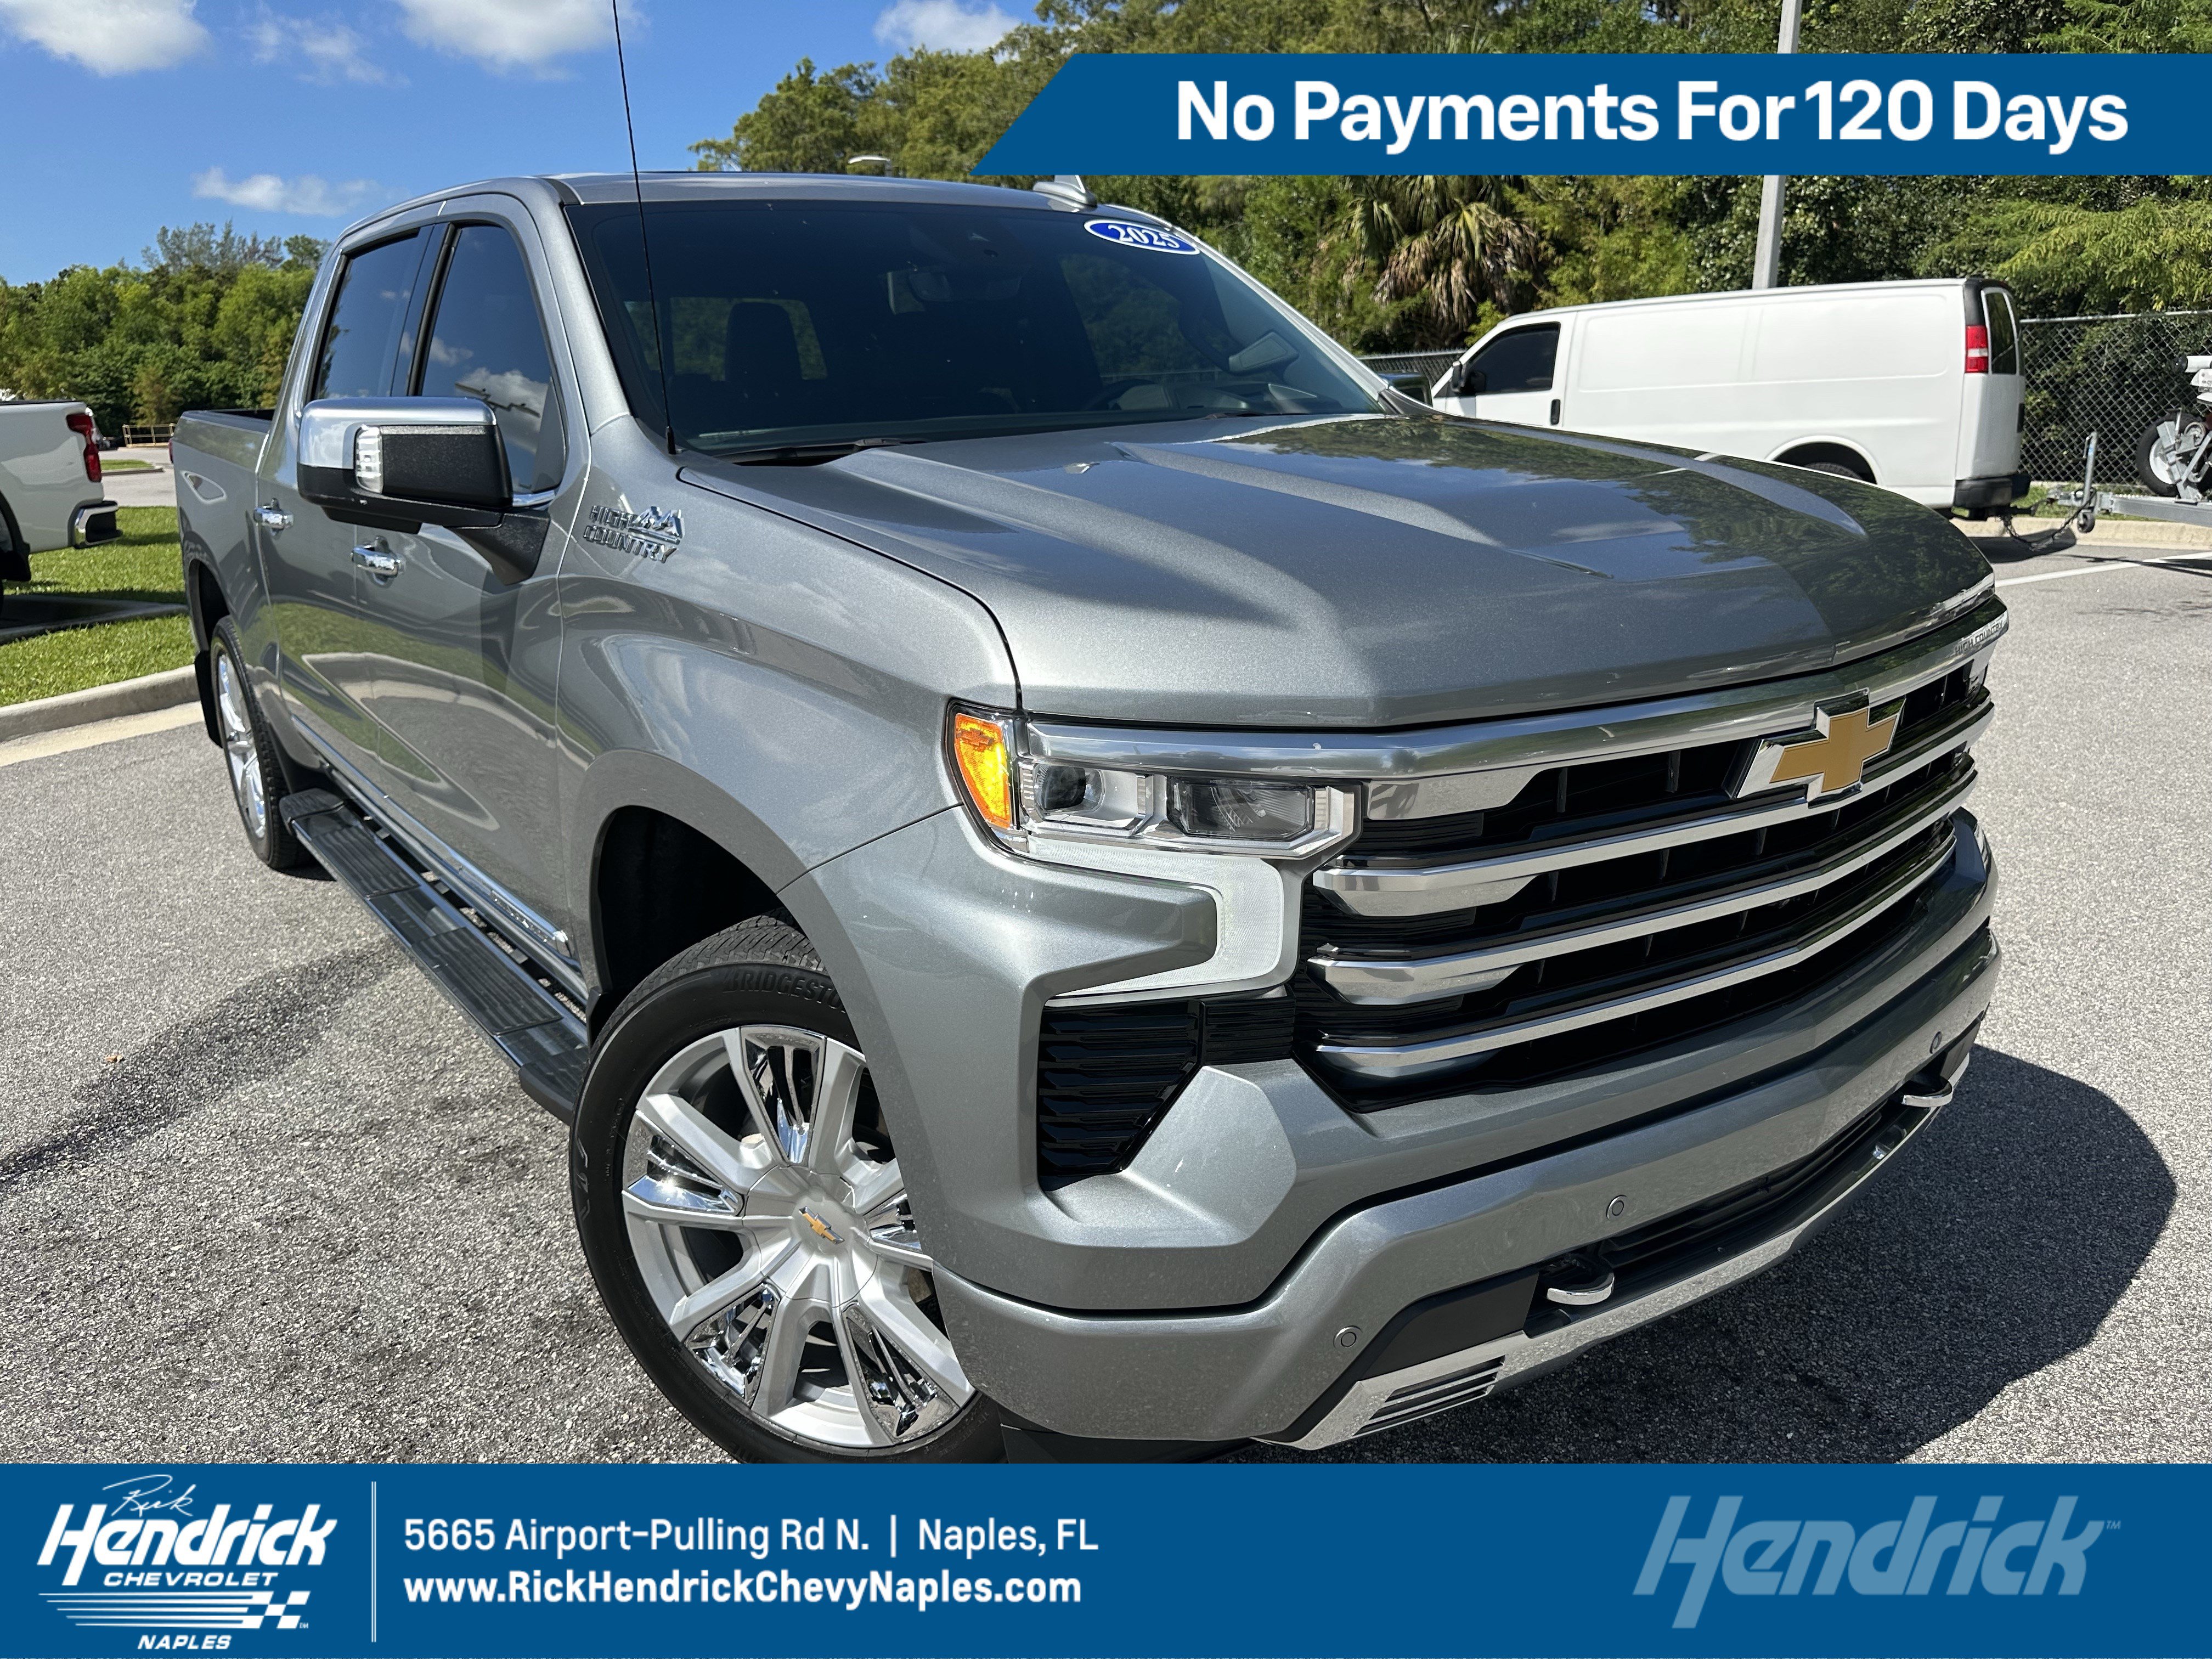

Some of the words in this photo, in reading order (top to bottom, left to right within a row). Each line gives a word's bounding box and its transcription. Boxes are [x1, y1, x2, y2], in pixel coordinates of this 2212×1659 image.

[1108, 224, 1180, 249] 2025
[589, 505, 639, 530] HIGH
[583, 525, 679, 564] COUNTRY
[1955, 638, 1973, 656] HIGH
[1974, 620, 2003, 644] COUNTRY
[721, 969, 846, 1014] BRIDGESTO
